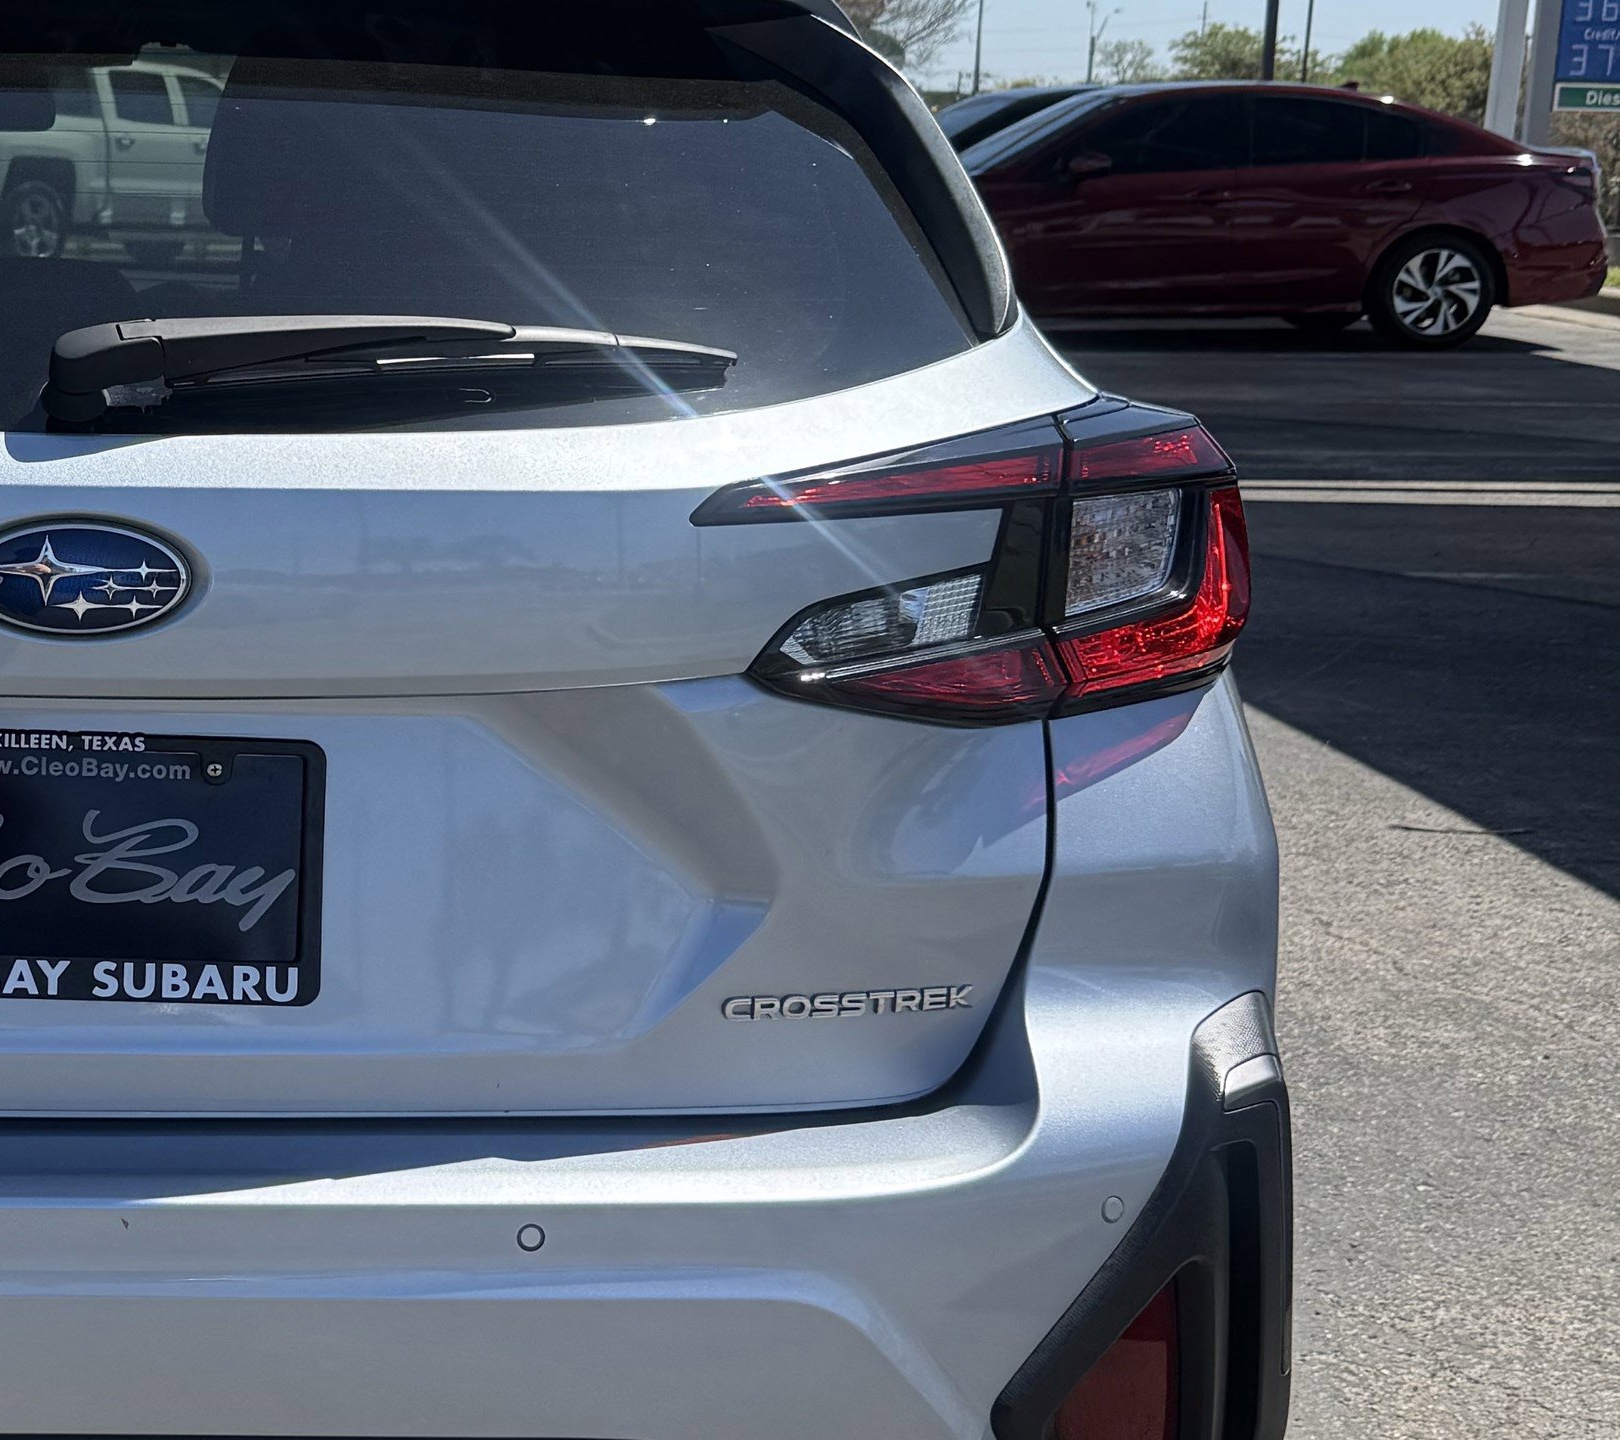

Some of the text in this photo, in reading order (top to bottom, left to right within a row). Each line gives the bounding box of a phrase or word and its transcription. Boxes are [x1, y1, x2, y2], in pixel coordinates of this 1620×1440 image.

[81, 734, 146, 753] TEXAS
[69, 808, 297, 932] Bay
[91, 960, 300, 1003] SUBARU
[721, 984, 974, 1022] CROSSTREK
